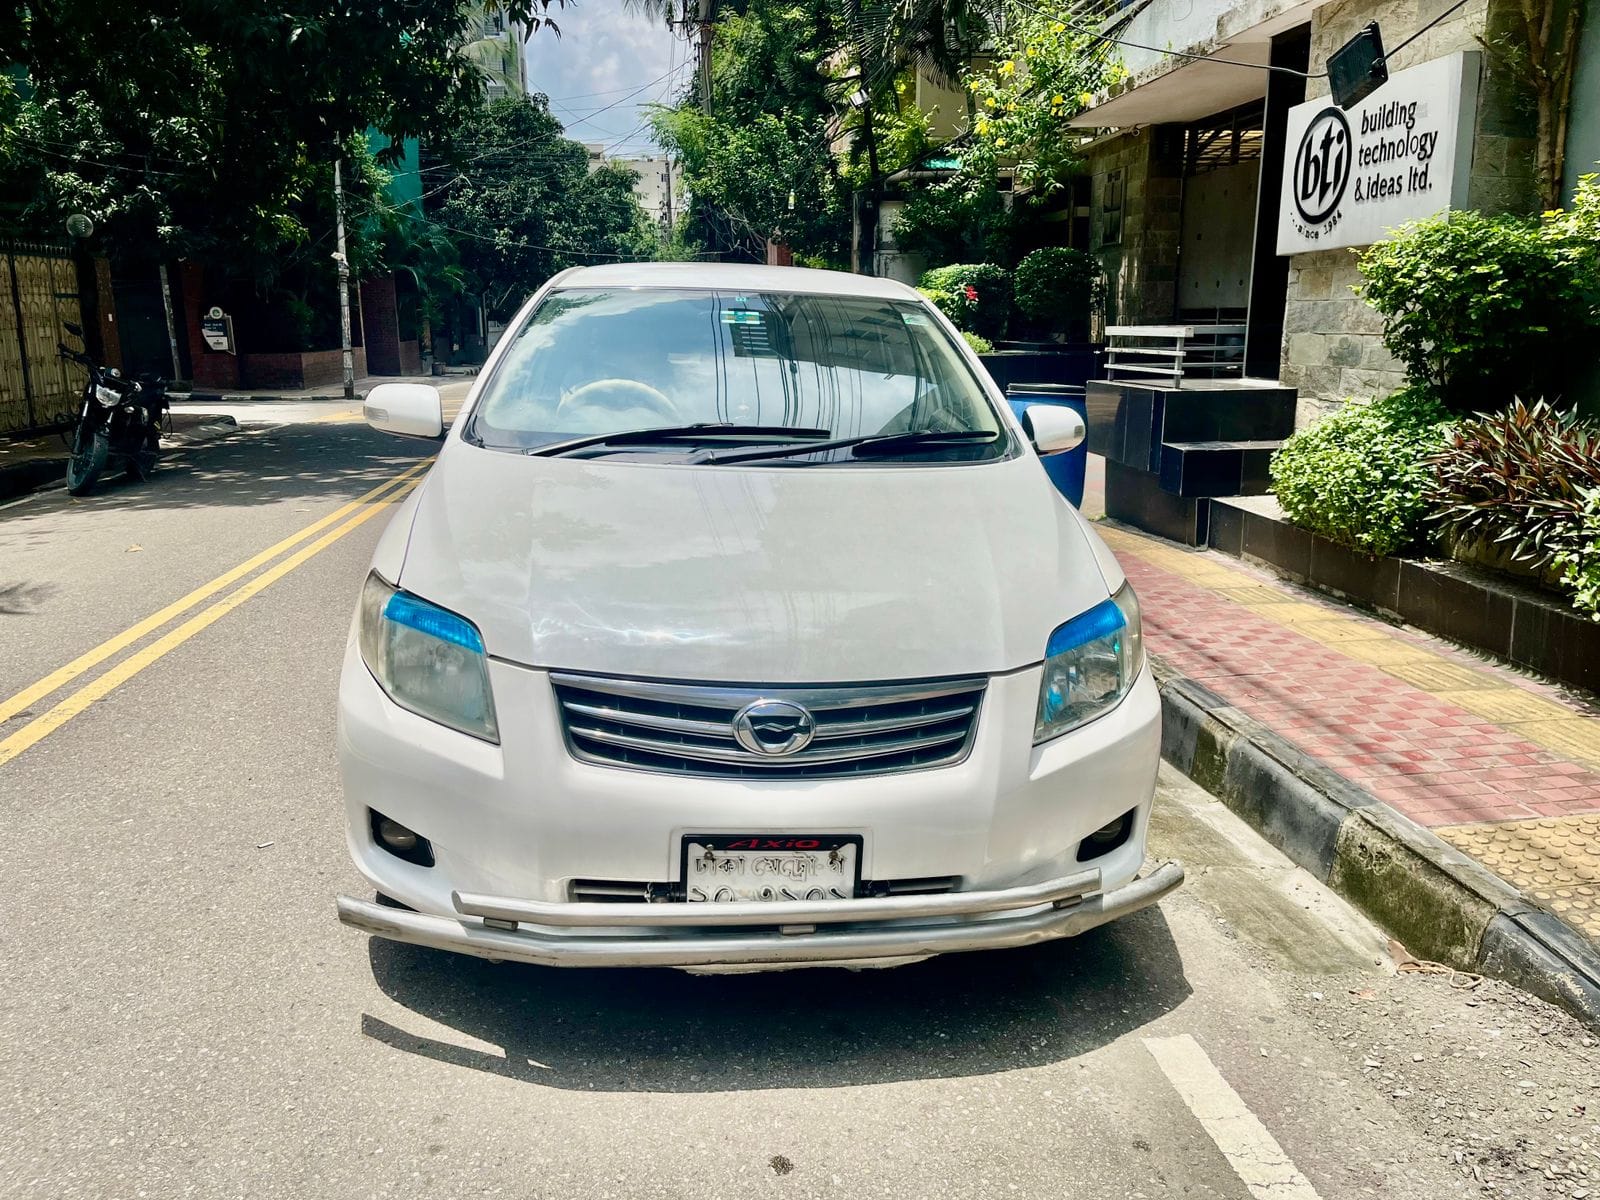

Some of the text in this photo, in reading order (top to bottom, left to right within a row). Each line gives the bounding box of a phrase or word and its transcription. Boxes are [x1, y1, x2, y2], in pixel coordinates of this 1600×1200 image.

[1361, 101, 1417, 135] building
[1301, 120, 1345, 209] bti
[1359, 130, 1438, 167] technology
[1355, 162, 1432, 202] & ideas ltd.
